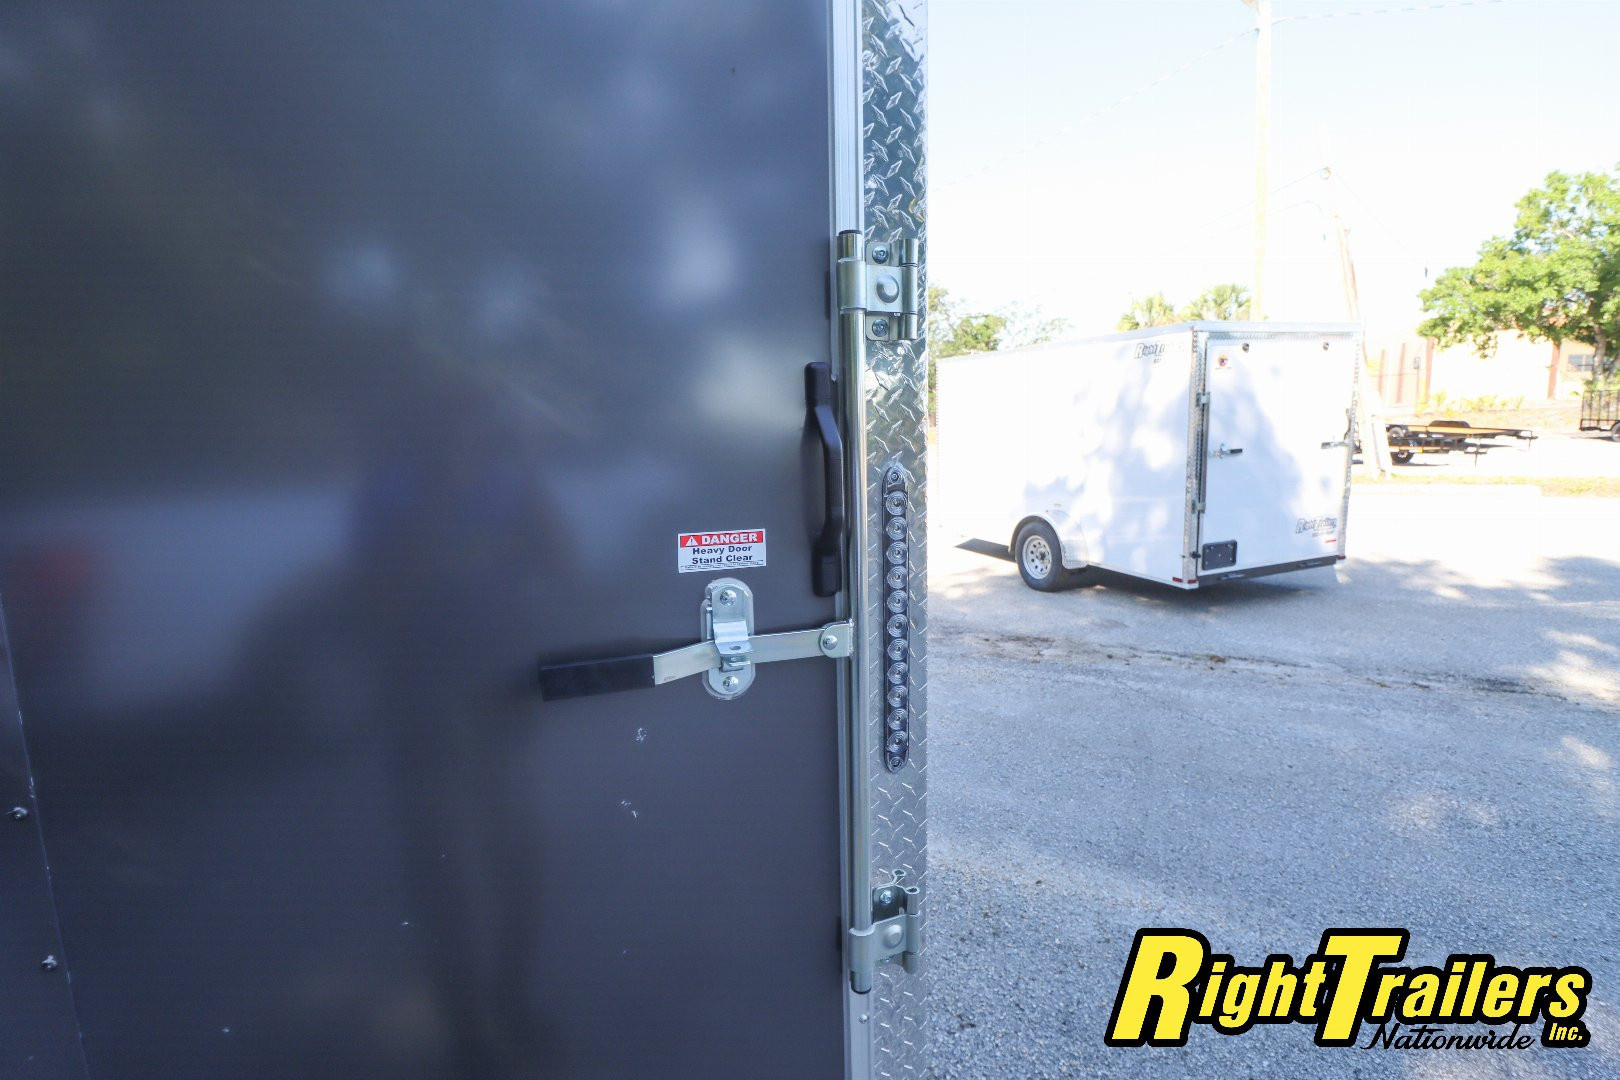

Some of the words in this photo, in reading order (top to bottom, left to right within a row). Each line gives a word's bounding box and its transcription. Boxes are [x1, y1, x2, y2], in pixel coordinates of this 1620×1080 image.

[701, 533, 758, 545] DANGER
[692, 547, 725, 555] Heavy
[728, 545, 753, 553] Door
[692, 555, 722, 565] Stand
[726, 554, 753, 562] Clear
